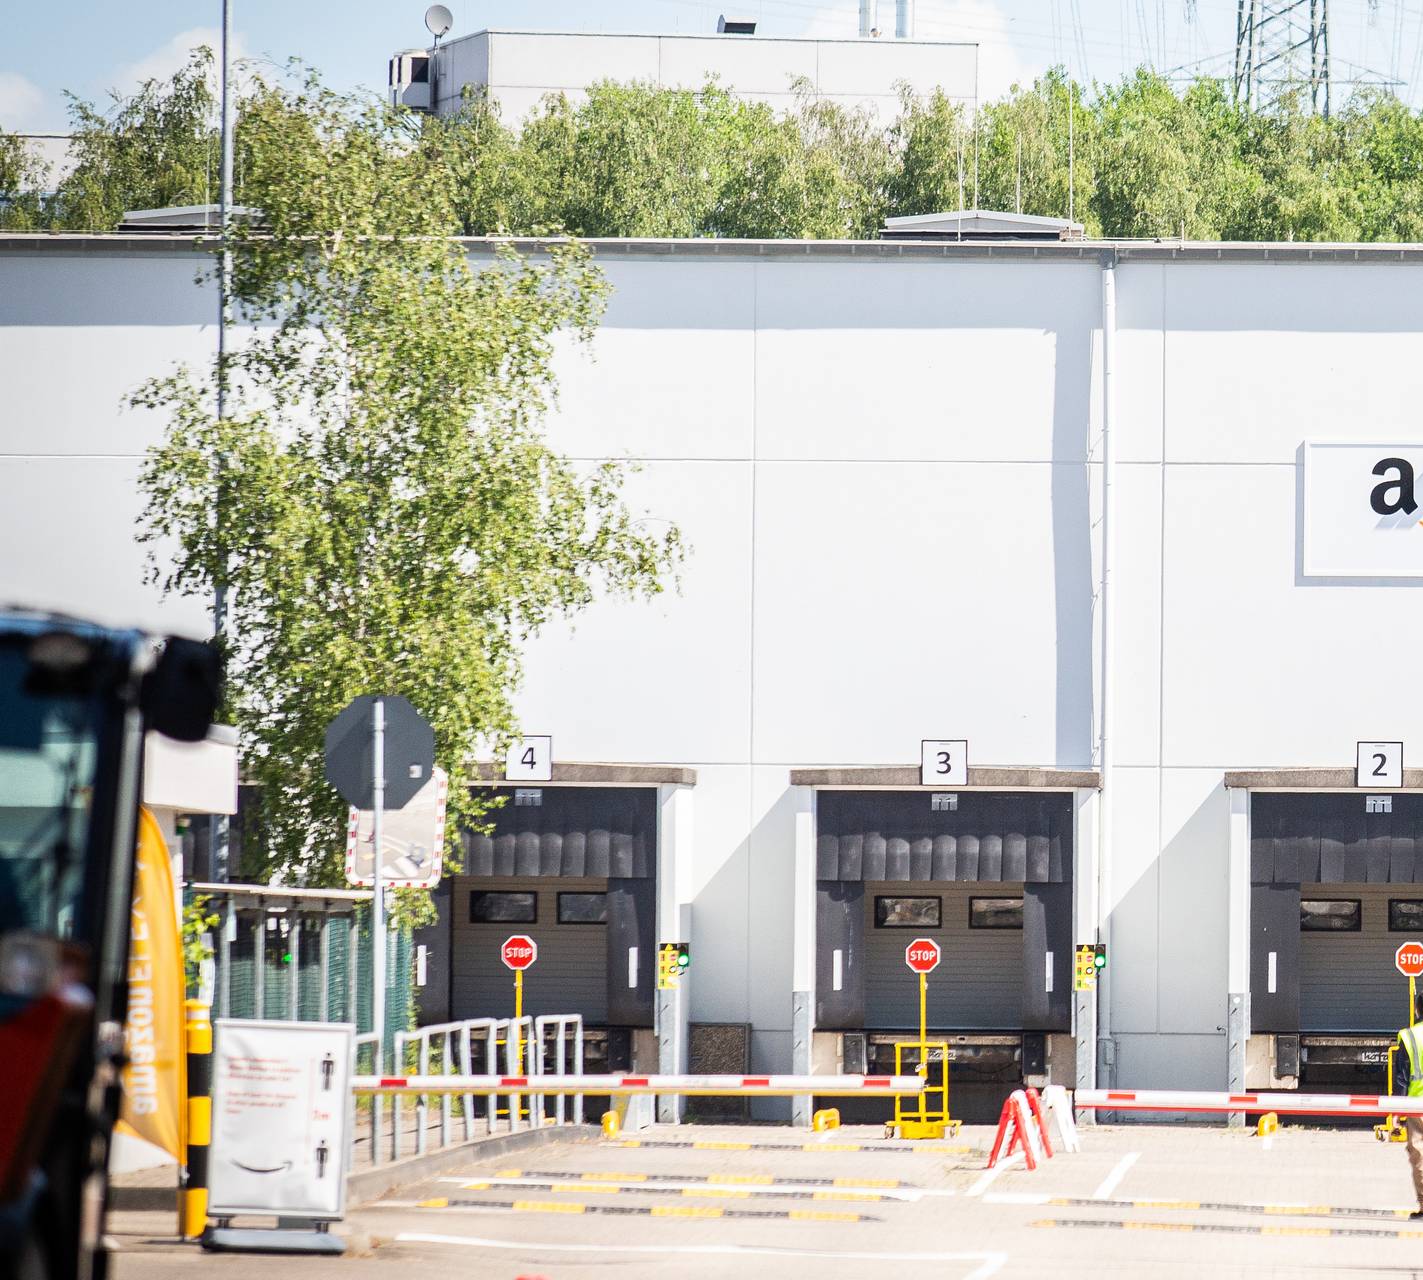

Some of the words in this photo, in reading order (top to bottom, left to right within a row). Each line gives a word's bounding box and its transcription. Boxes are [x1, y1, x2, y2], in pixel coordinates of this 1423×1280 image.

[521, 747, 537, 770] 4
[936, 751, 952, 775] 3
[1372, 753, 1388, 776] 2
[505, 947, 533, 958] STOP
[910, 950, 937, 961] STOP
